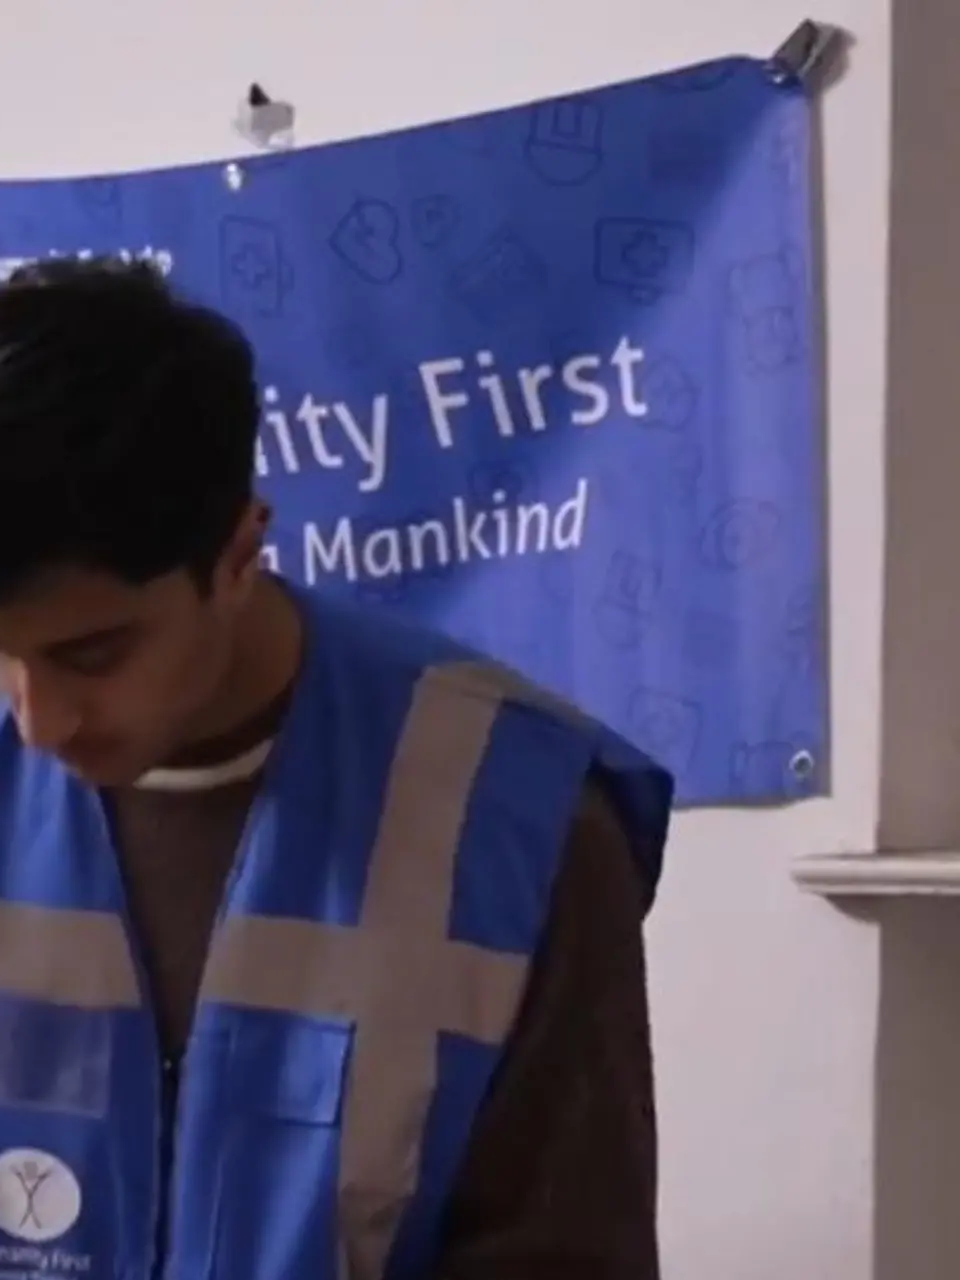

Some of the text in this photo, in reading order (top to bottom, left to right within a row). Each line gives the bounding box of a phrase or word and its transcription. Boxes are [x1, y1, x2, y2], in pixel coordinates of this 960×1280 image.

[255, 336, 649, 493] ity First
[303, 477, 588, 587] Mankind
